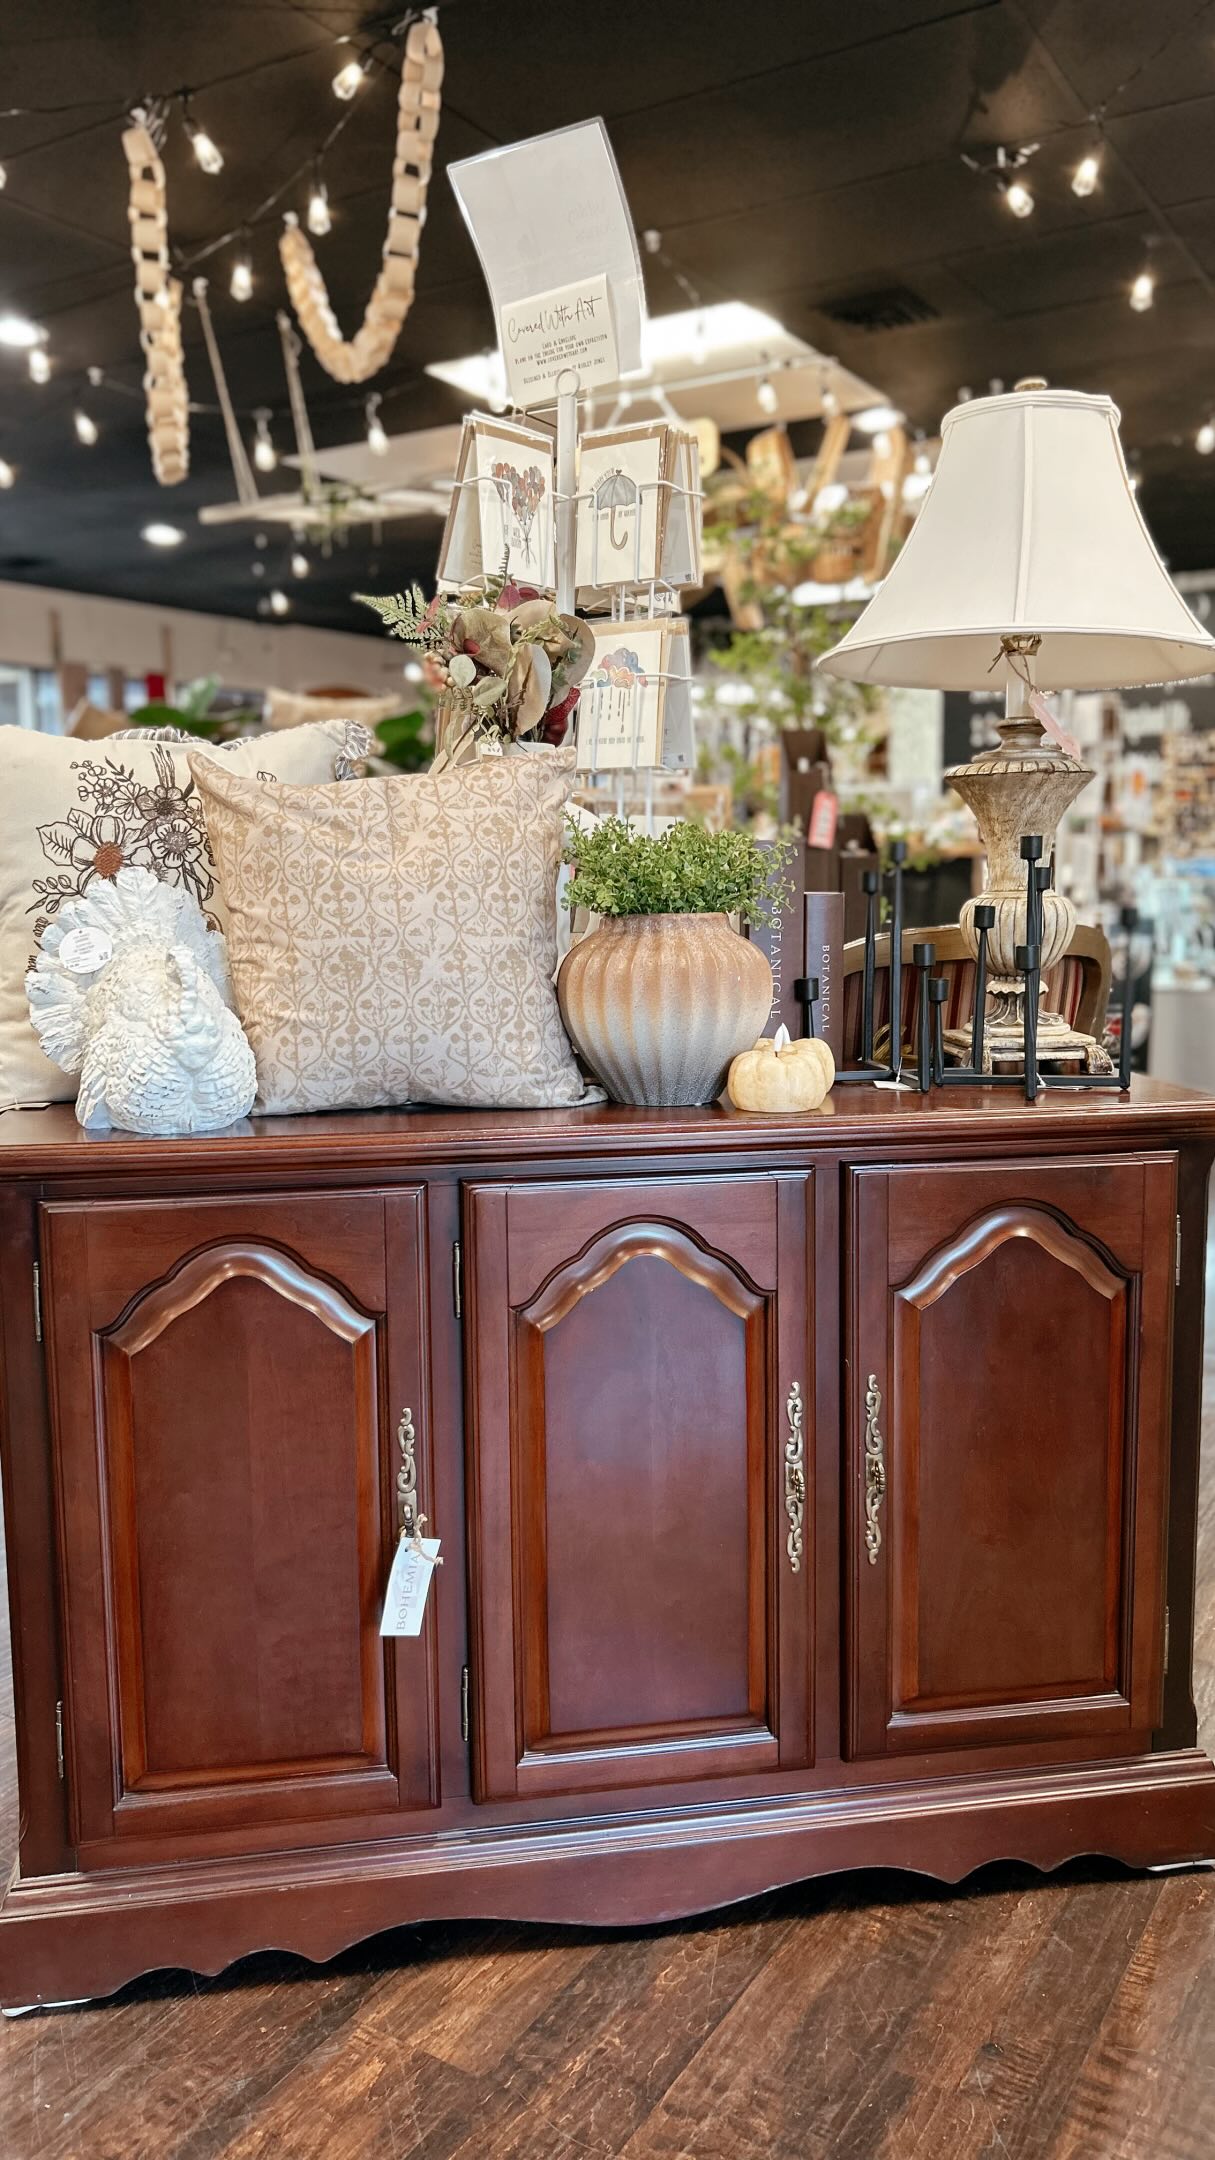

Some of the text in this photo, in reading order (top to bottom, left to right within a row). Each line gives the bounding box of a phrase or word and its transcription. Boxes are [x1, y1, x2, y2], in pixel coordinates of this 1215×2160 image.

[508, 296, 602, 343] Covered With Art
[771, 906, 782, 1019] BOTANICAL
[822, 945, 830, 1032] BOTANICAL
